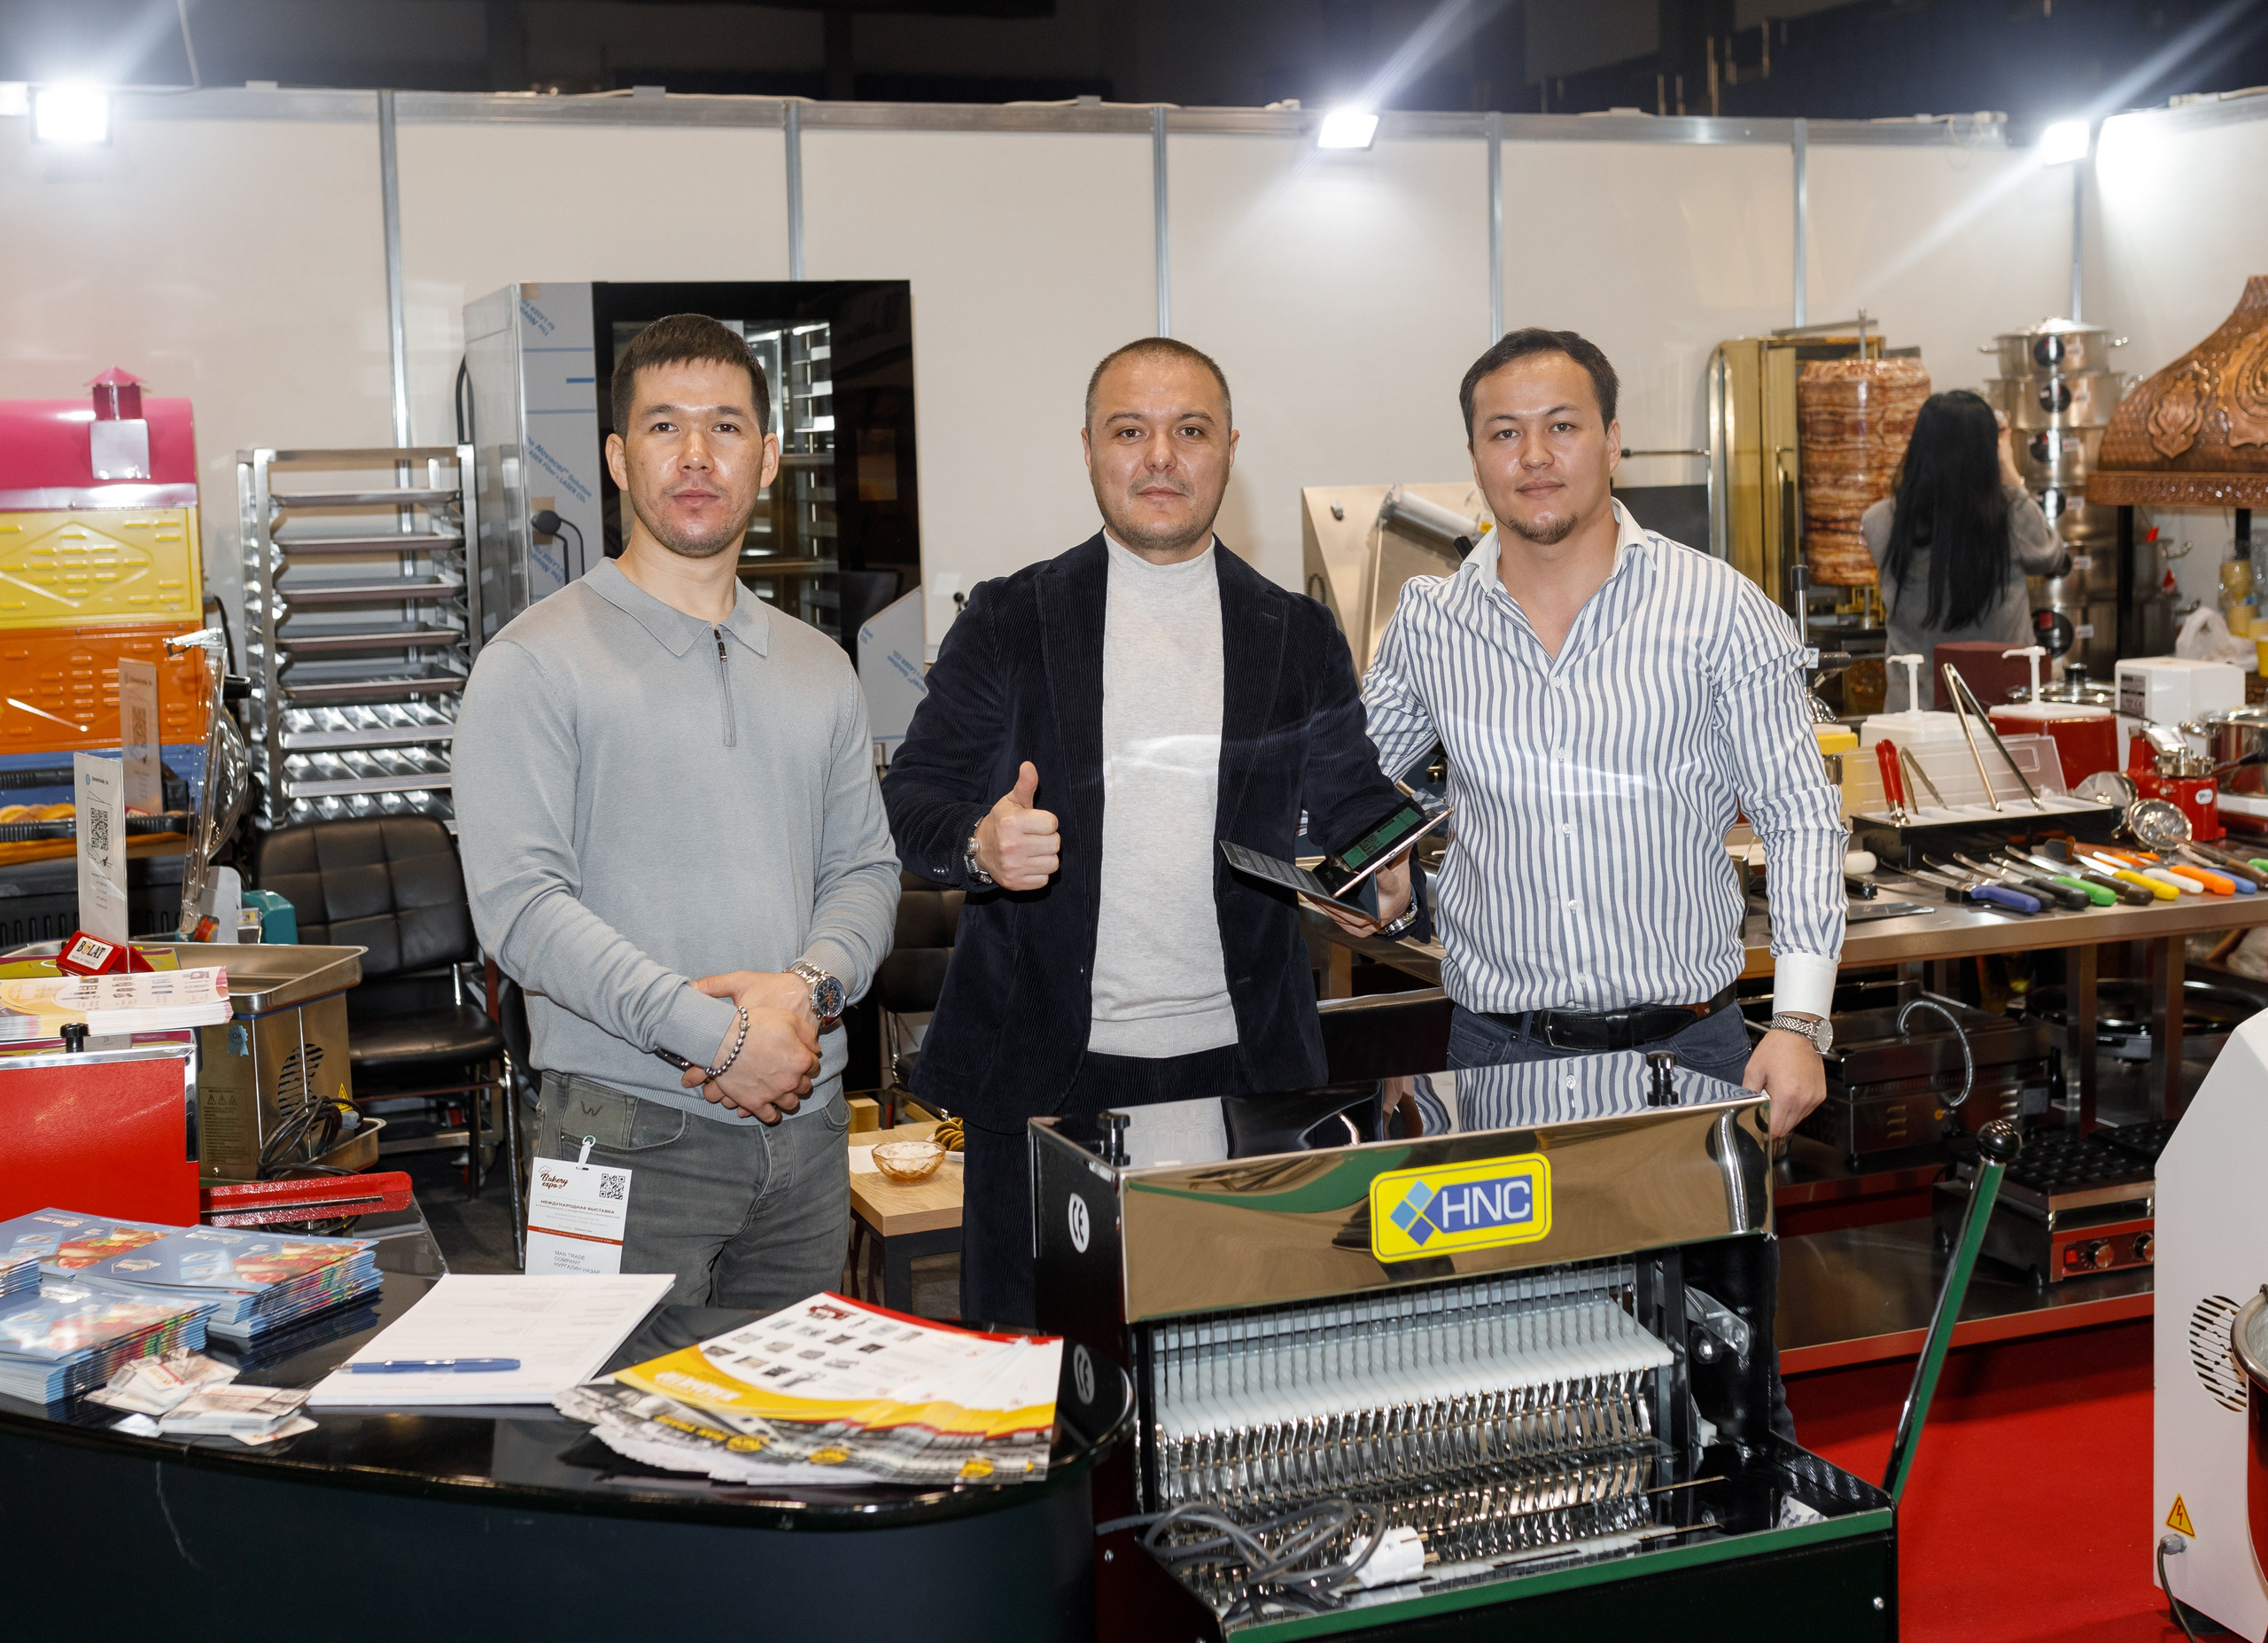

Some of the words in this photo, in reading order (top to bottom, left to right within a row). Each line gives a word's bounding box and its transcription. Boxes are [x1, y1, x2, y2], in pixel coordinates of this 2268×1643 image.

[540, 1172, 569, 1186] Bakery
[541, 1181, 557, 1190] expo
[540, 1199, 586, 1211] МЕЖДУНАРОДНАЯ
[1441, 1180, 1531, 1228] HNC
[554, 1256, 581, 1265] COMPANY
